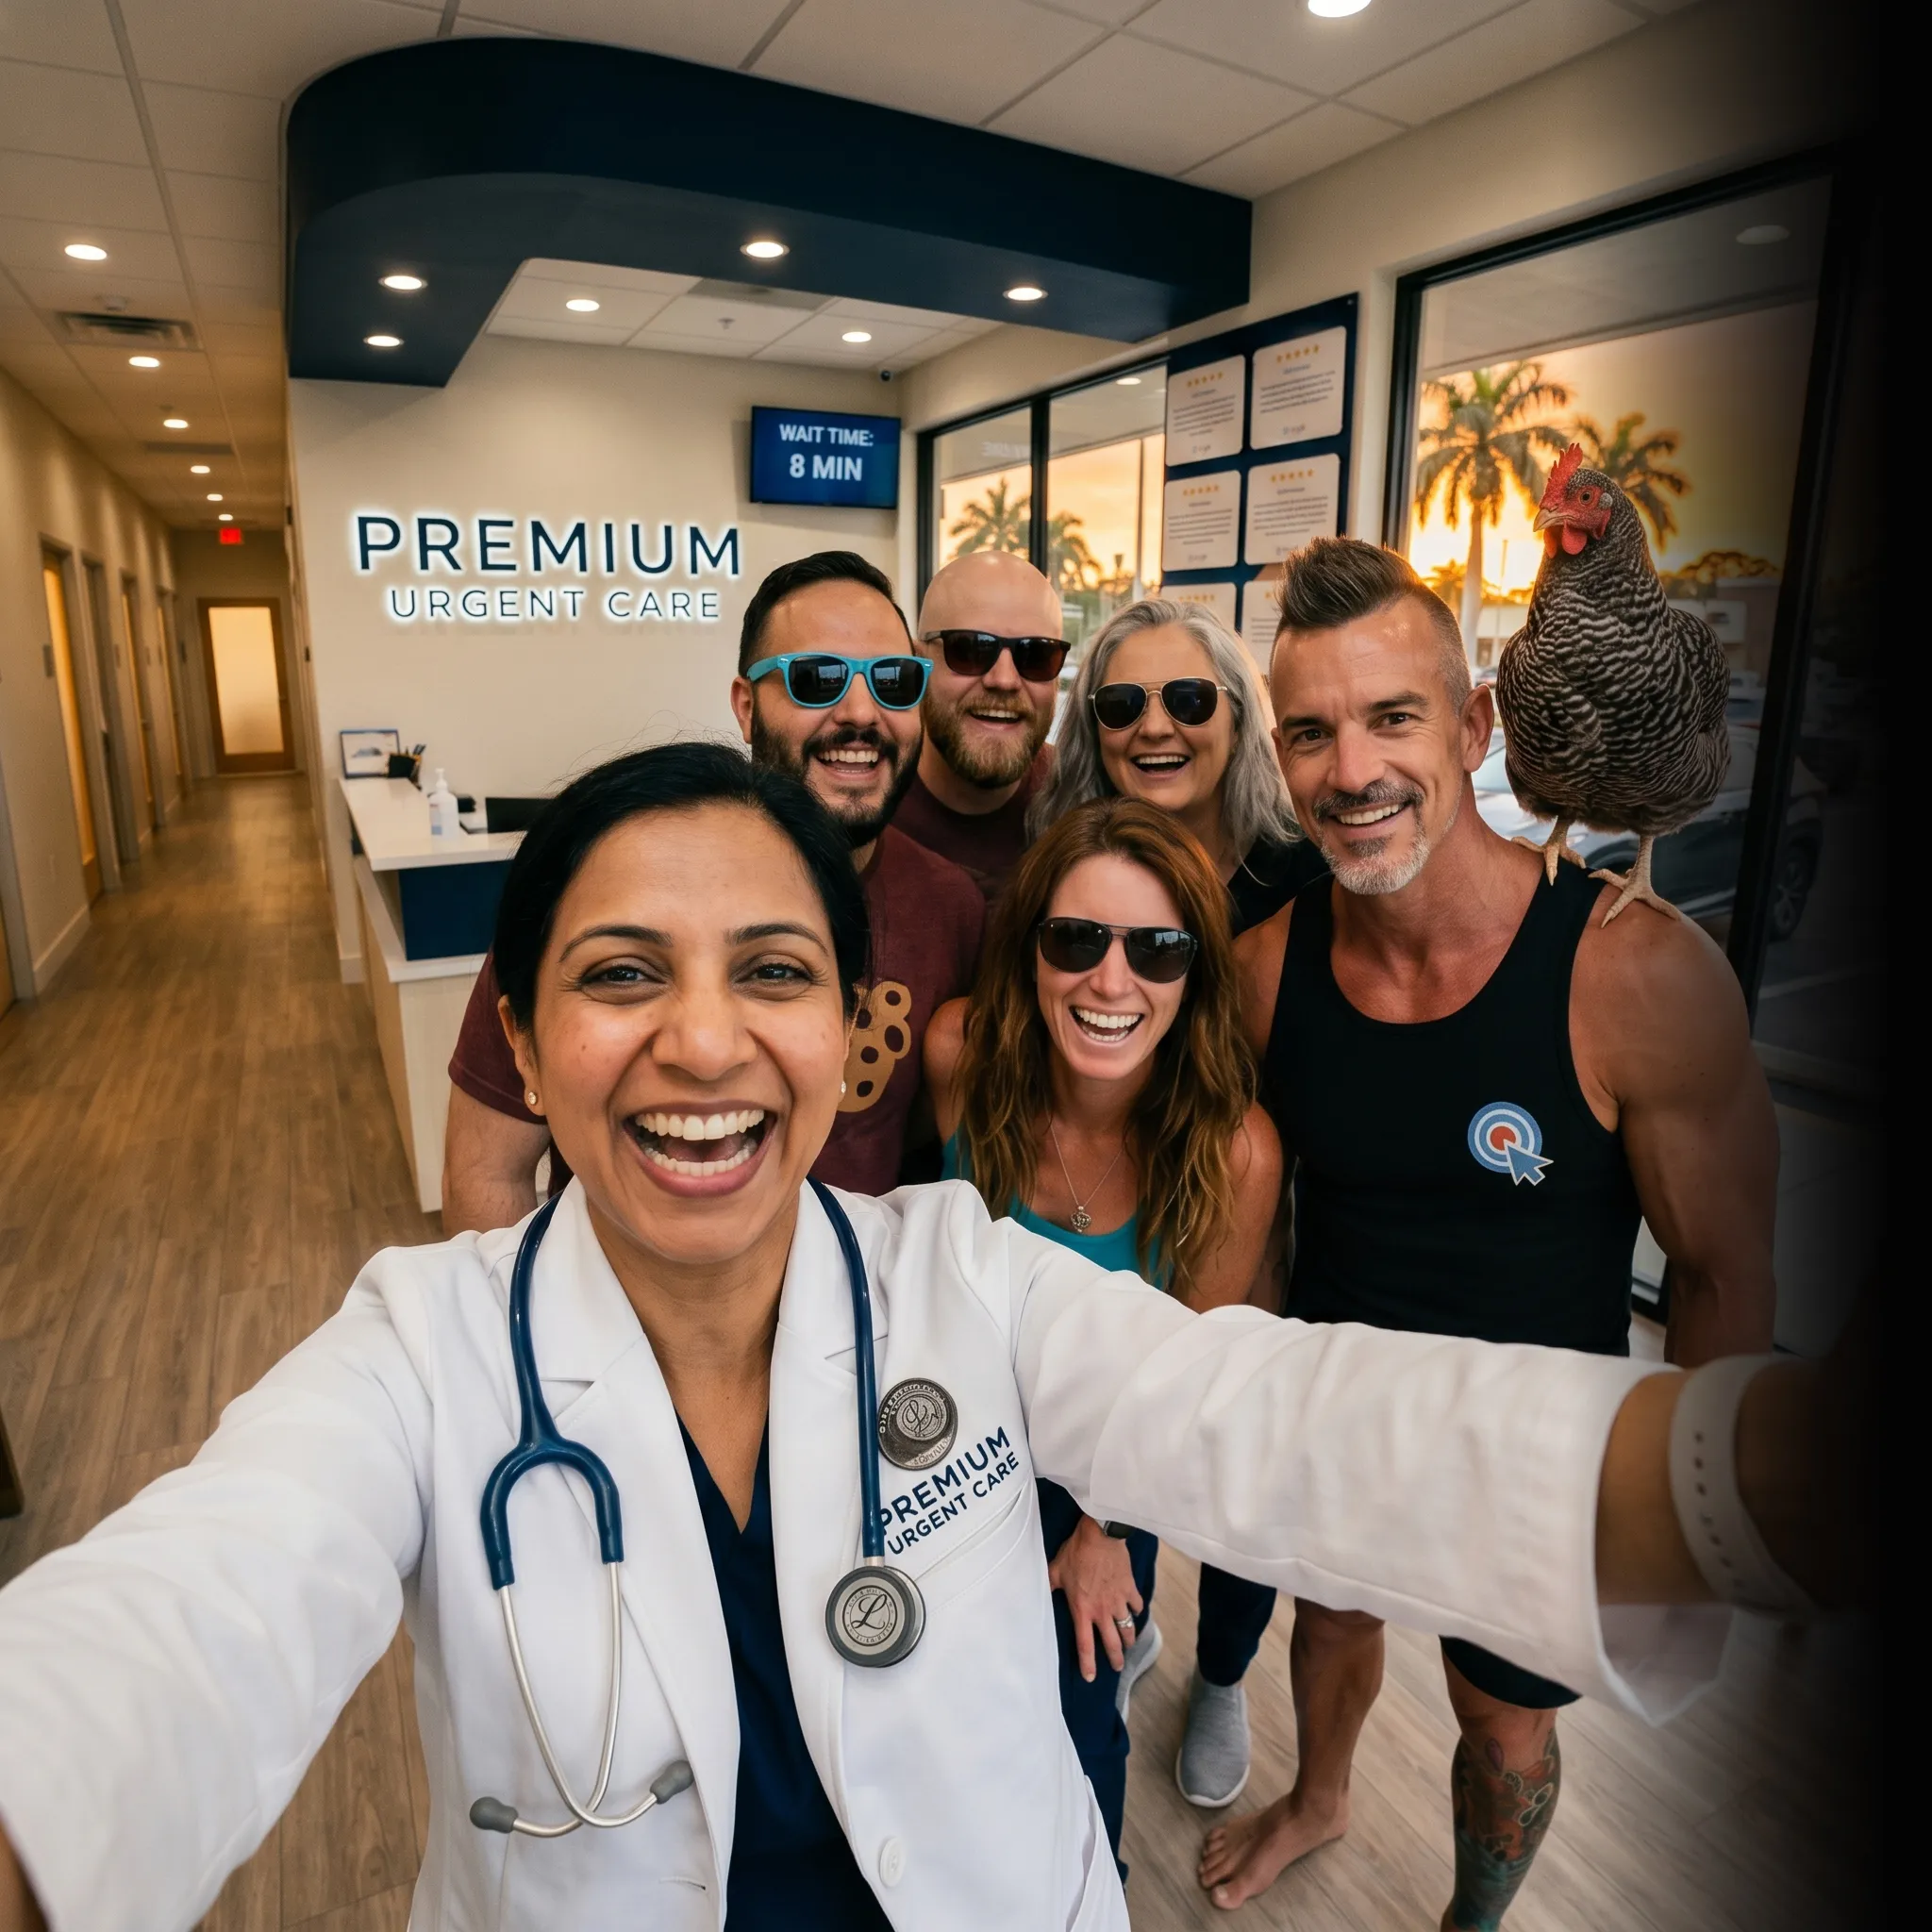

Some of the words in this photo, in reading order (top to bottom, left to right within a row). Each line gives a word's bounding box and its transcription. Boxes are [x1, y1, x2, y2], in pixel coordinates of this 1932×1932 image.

[779, 424, 824, 444] WAIT
[826, 426, 874, 447] TIME:
[790, 453, 806, 479] 8
[812, 454, 863, 482] MIN
[358, 516, 739, 575] PREMIUM
[391, 590, 584, 618] URGENT
[608, 591, 719, 618] CARE
[887, 1492, 968, 1556] URGENT
[973, 1451, 1020, 1498] CARE
